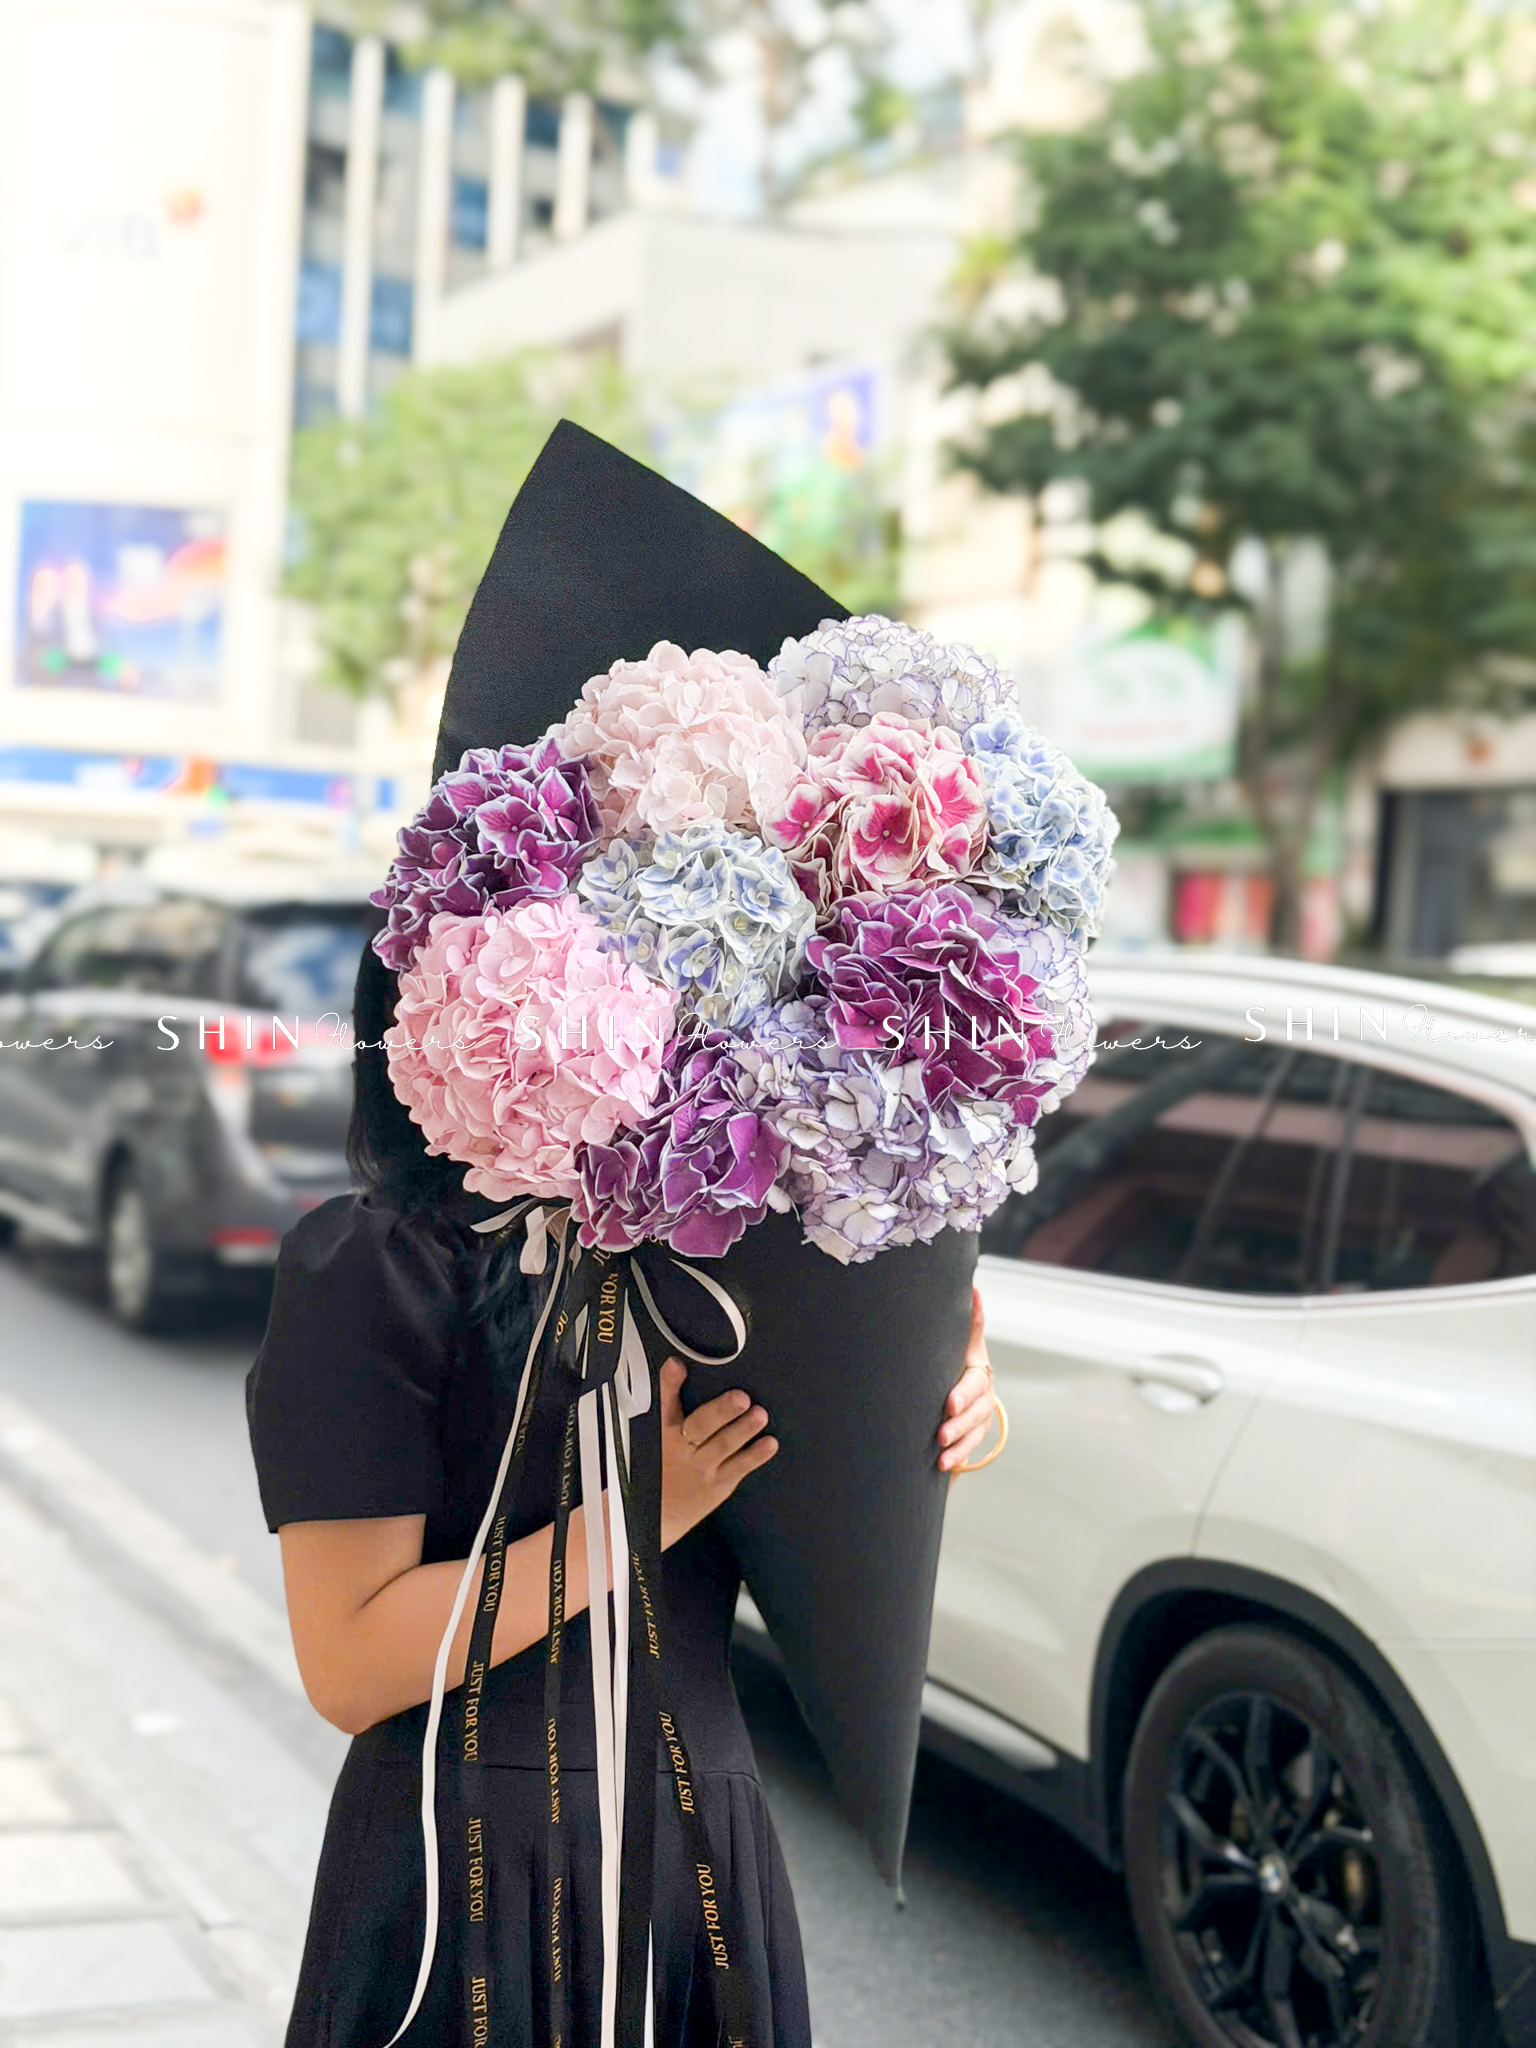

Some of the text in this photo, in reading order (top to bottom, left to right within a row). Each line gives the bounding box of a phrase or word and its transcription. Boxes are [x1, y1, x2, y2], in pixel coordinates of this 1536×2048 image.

[597, 1309, 616, 1344] YOU
[483, 1516, 506, 1612] JUST FOR YOU
[553, 1560, 563, 1593] YOU
[550, 1628, 561, 1664] JUST
[647, 1616, 660, 1659] JUST
[463, 1661, 485, 1761] JUST FOR YOU
[547, 1718, 560, 1824] JUST FOR YOU
[659, 1711, 696, 1815] JUST FOR YOU
[468, 1817, 484, 1922] JUST FOR YOU
[552, 1877, 562, 1912] YOU
[696, 1863, 730, 1970] JUST FOR YOU
[472, 1976, 488, 2048] JUST FOR
